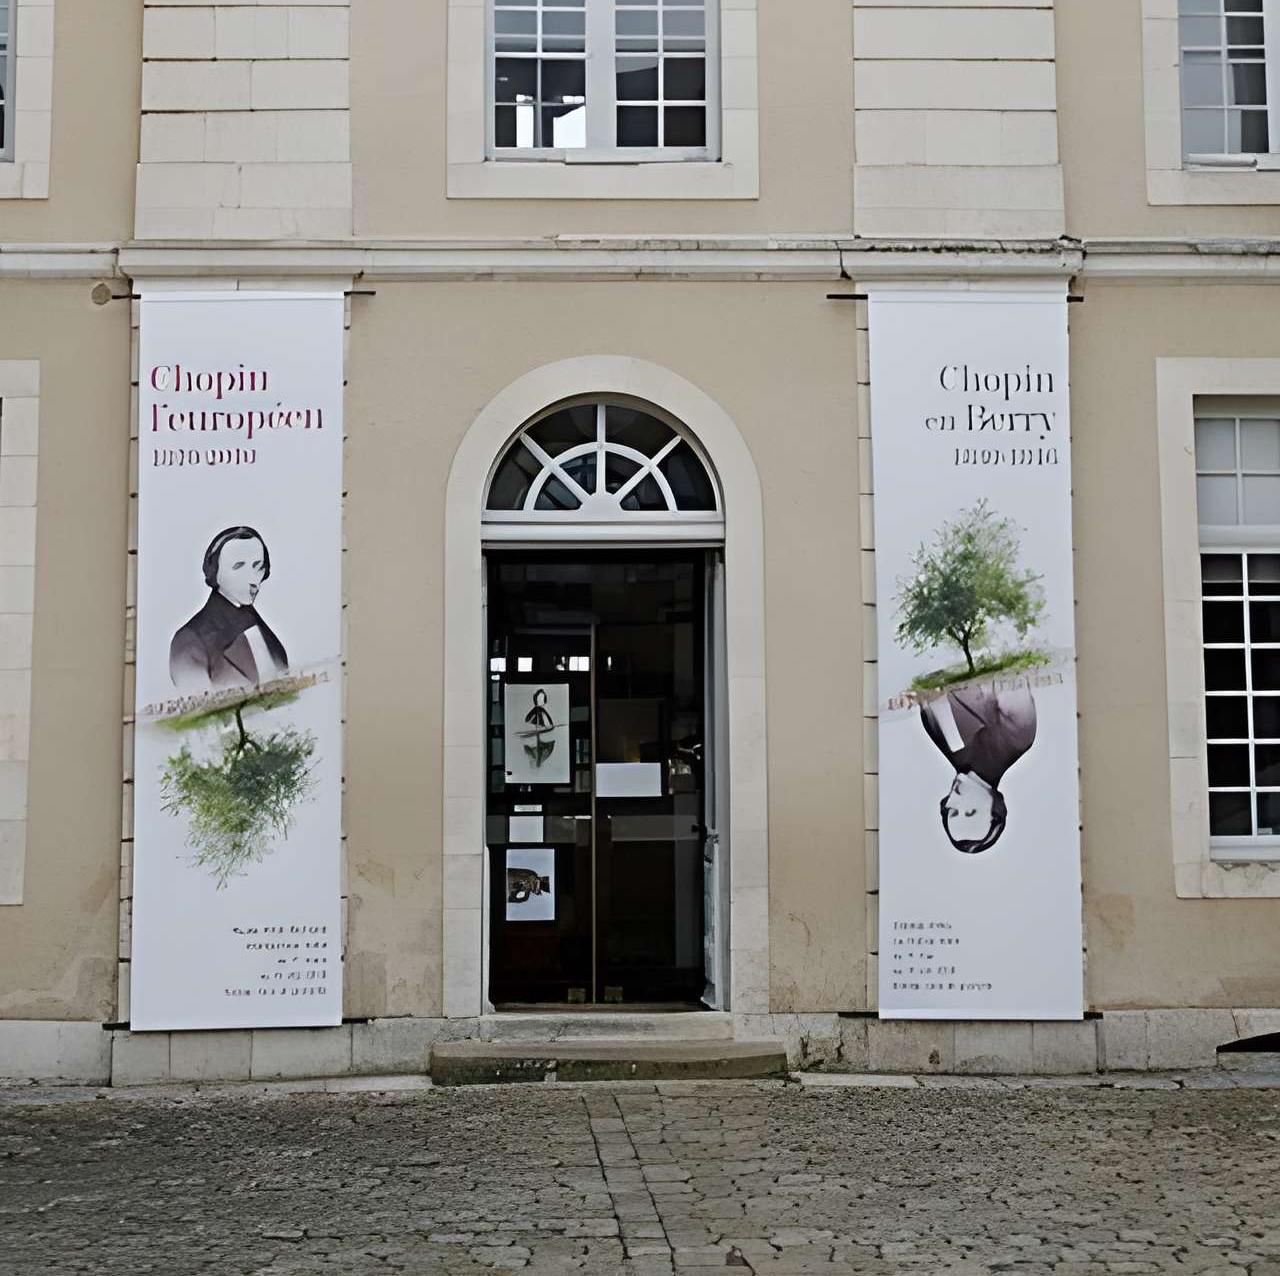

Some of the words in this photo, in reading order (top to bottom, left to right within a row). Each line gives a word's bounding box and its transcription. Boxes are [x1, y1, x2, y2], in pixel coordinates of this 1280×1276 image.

[151, 364, 268, 400] Chopin
[939, 364, 1054, 401] Chopin
[925, 415, 955, 431] en
[967, 404, 1056, 441] Berry
